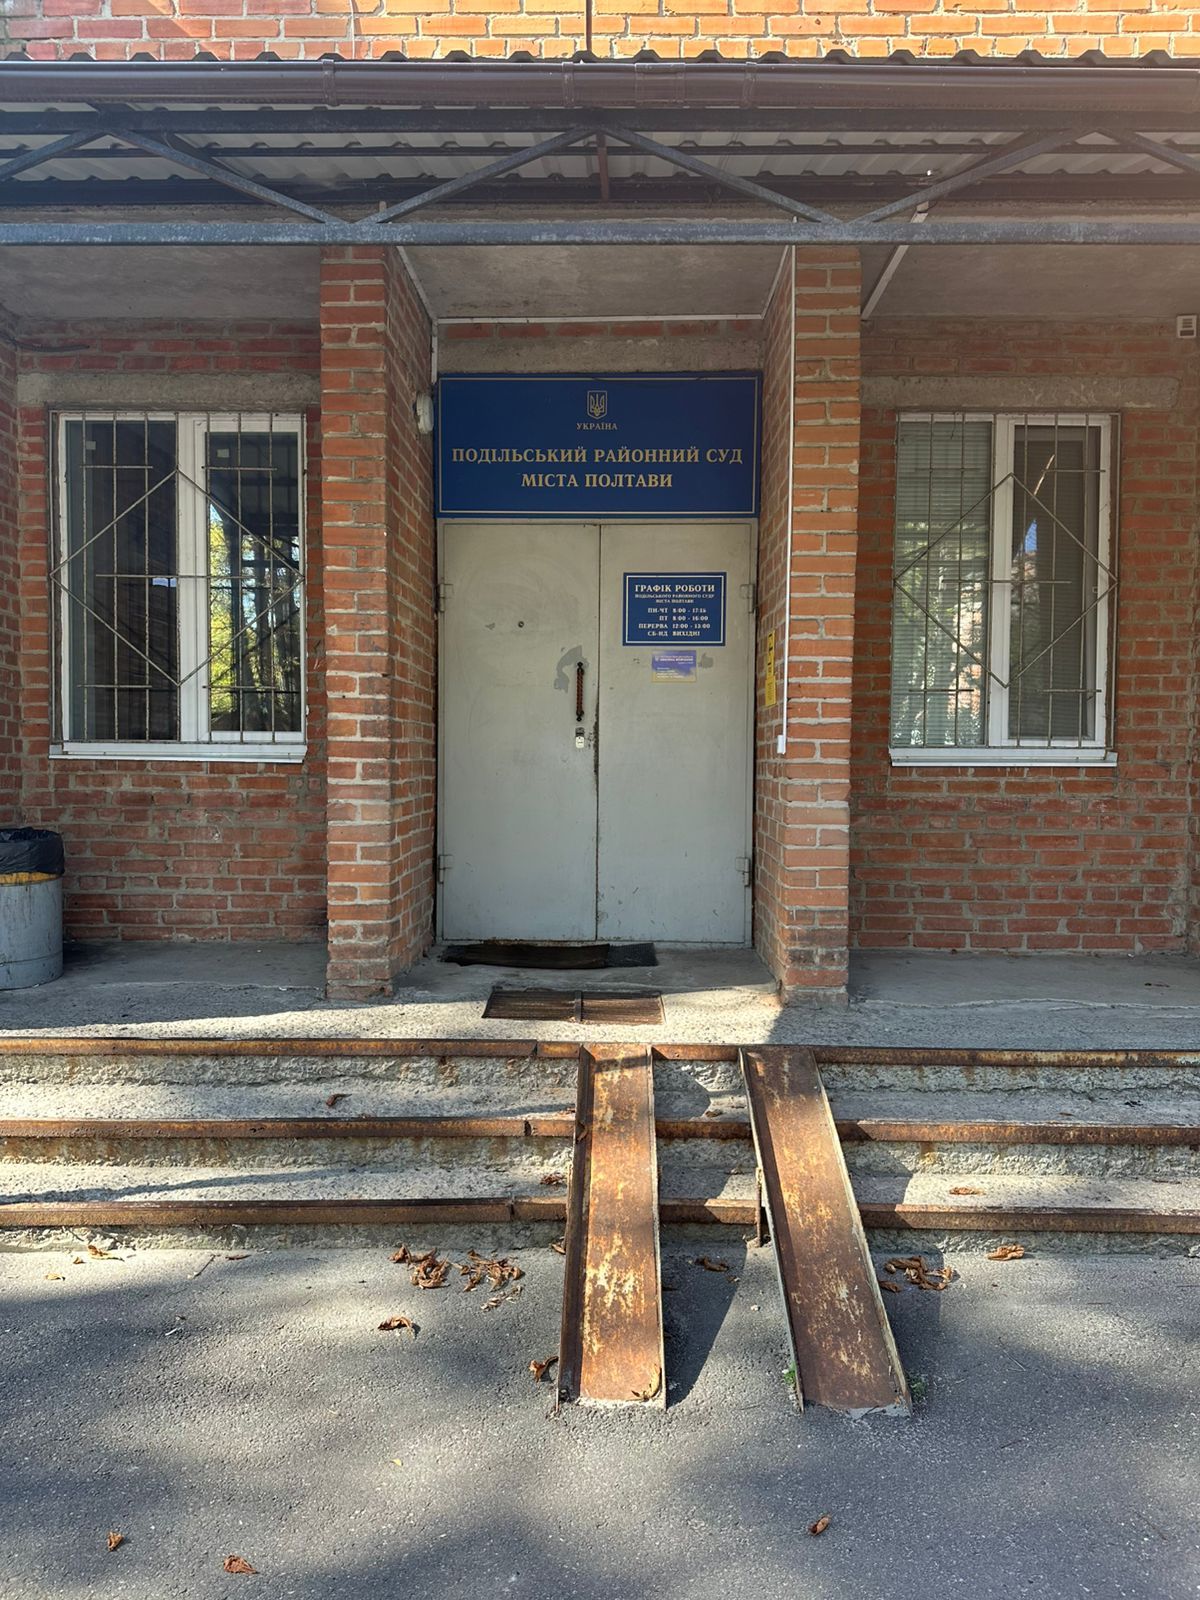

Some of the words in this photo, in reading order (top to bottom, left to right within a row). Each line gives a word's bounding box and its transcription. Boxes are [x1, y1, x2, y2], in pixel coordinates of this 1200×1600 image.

[576, 422, 618, 431] УКРАЇНА
[452, 446, 587, 464] ПОДІЛЬСЬКИЙ
[594, 446, 700, 463] РАЙОННИЙ
[706, 448, 744, 464] СУД
[521, 473, 578, 488] МІСТА
[585, 473, 673, 487] ПОЛТАВИ
[634, 584, 672, 592] ГРАФІК
[675, 584, 715, 592] РОБОТИ
